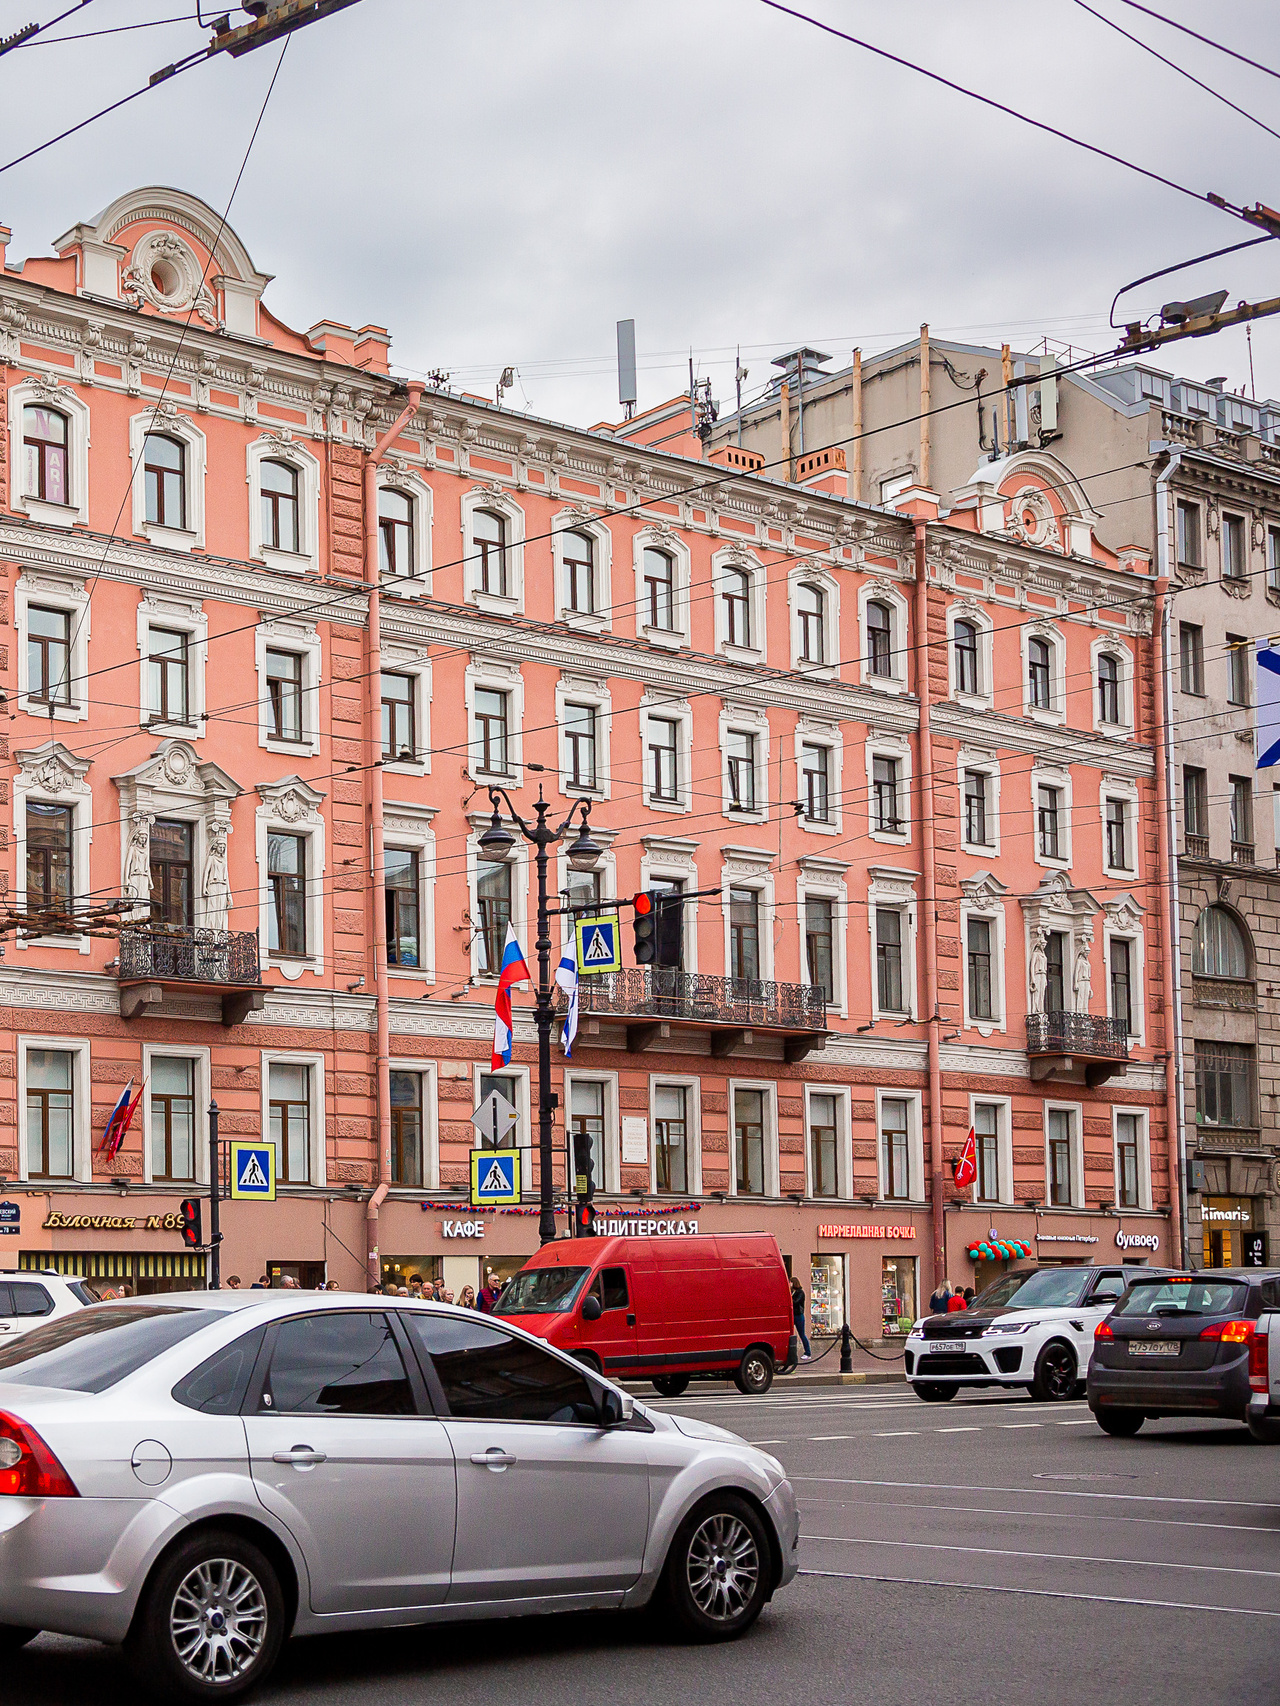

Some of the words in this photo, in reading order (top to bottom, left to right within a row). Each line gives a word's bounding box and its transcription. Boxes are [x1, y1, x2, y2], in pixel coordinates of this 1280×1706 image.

[34, 409, 52, 436] N
[49, 452, 61, 499] ART
[44, 1211, 136, 1227] Булочная
[592, 1219, 699, 1236] НДИТЕРСКАЯ
[442, 1219, 485, 1238] КАФЕ
[819, 1224, 886, 1238] МАРМЕЛАДНАЯ
[886, 1226, 917, 1239] БОЧКА
